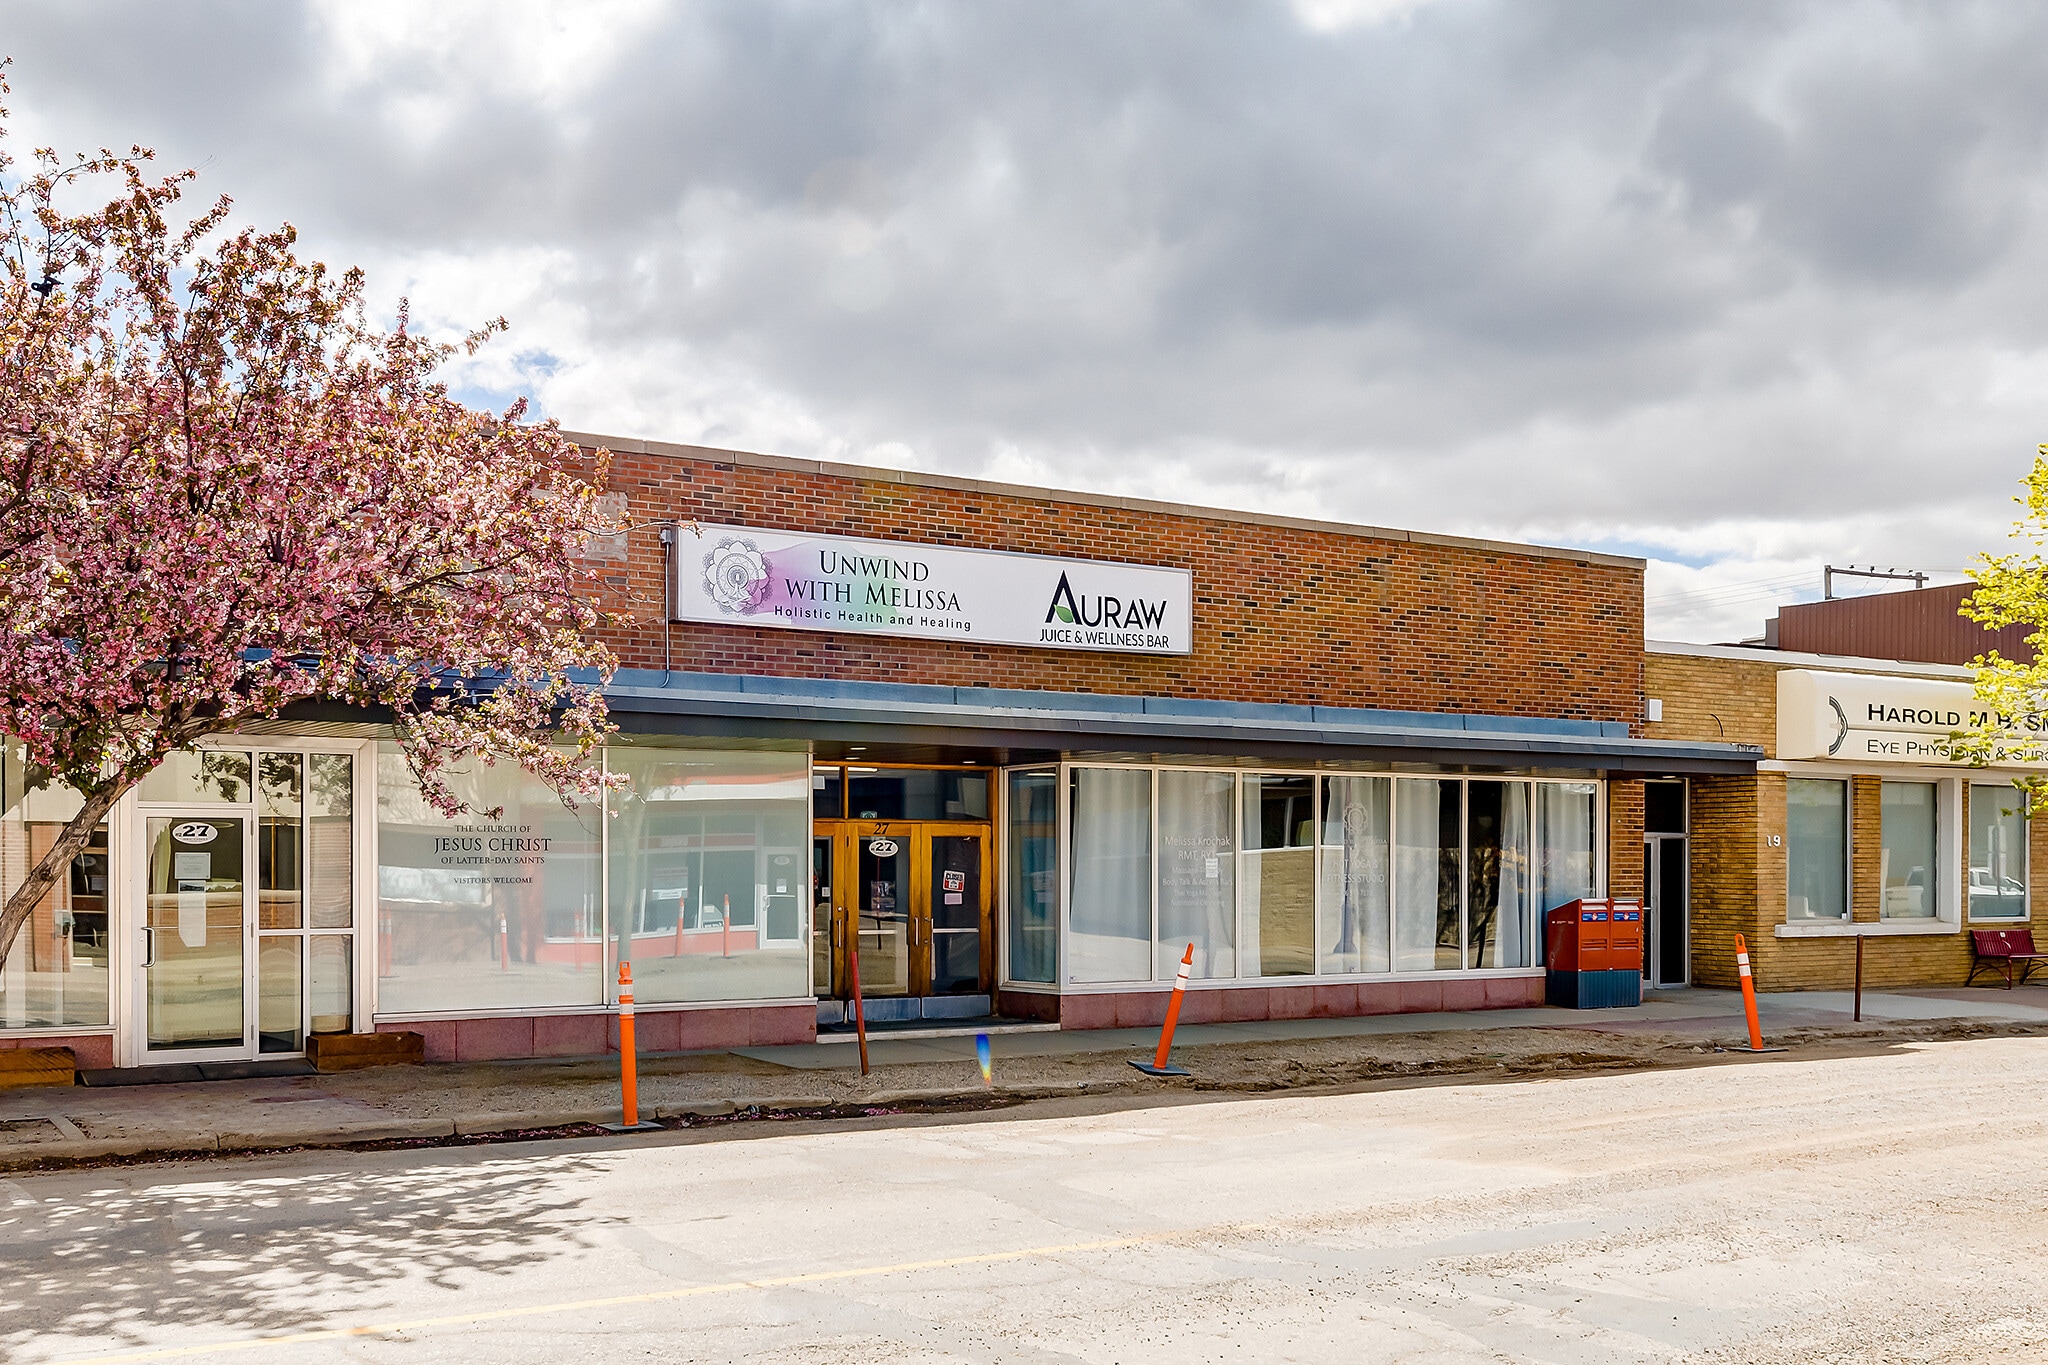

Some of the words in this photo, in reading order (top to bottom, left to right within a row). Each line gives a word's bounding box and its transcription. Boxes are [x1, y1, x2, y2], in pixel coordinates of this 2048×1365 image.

[819, 550, 930, 582] UNWIND
[785, 578, 852, 604] WITH
[865, 582, 962, 612] MELISSA
[1045, 570, 1167, 630] AURAW
[774, 606, 831, 619] Holistic
[838, 610, 883, 623] Health
[890, 616, 913, 626] and
[920, 619, 971, 632] Healing
[1040, 629, 1071, 642] JUICE
[1074, 630, 1082, 644] &
[1086, 631, 1144, 647] WELLNESS
[1147, 635, 1169, 648] BAR
[1868, 704, 1960, 726] HAROLD
[1867, 740, 1900, 754] EYE
[1996, 747, 2007, 760] &
[873, 822, 889, 834] 27
[434, 838, 482, 854] JESUS
[489, 838, 551, 851] CHRIST
[1165, 836, 1196, 846] Melissa
[1198, 836, 1231, 846] Krochak
[1767, 835, 1780, 846] 19
[1357, 874, 1384, 883] STUDIO
